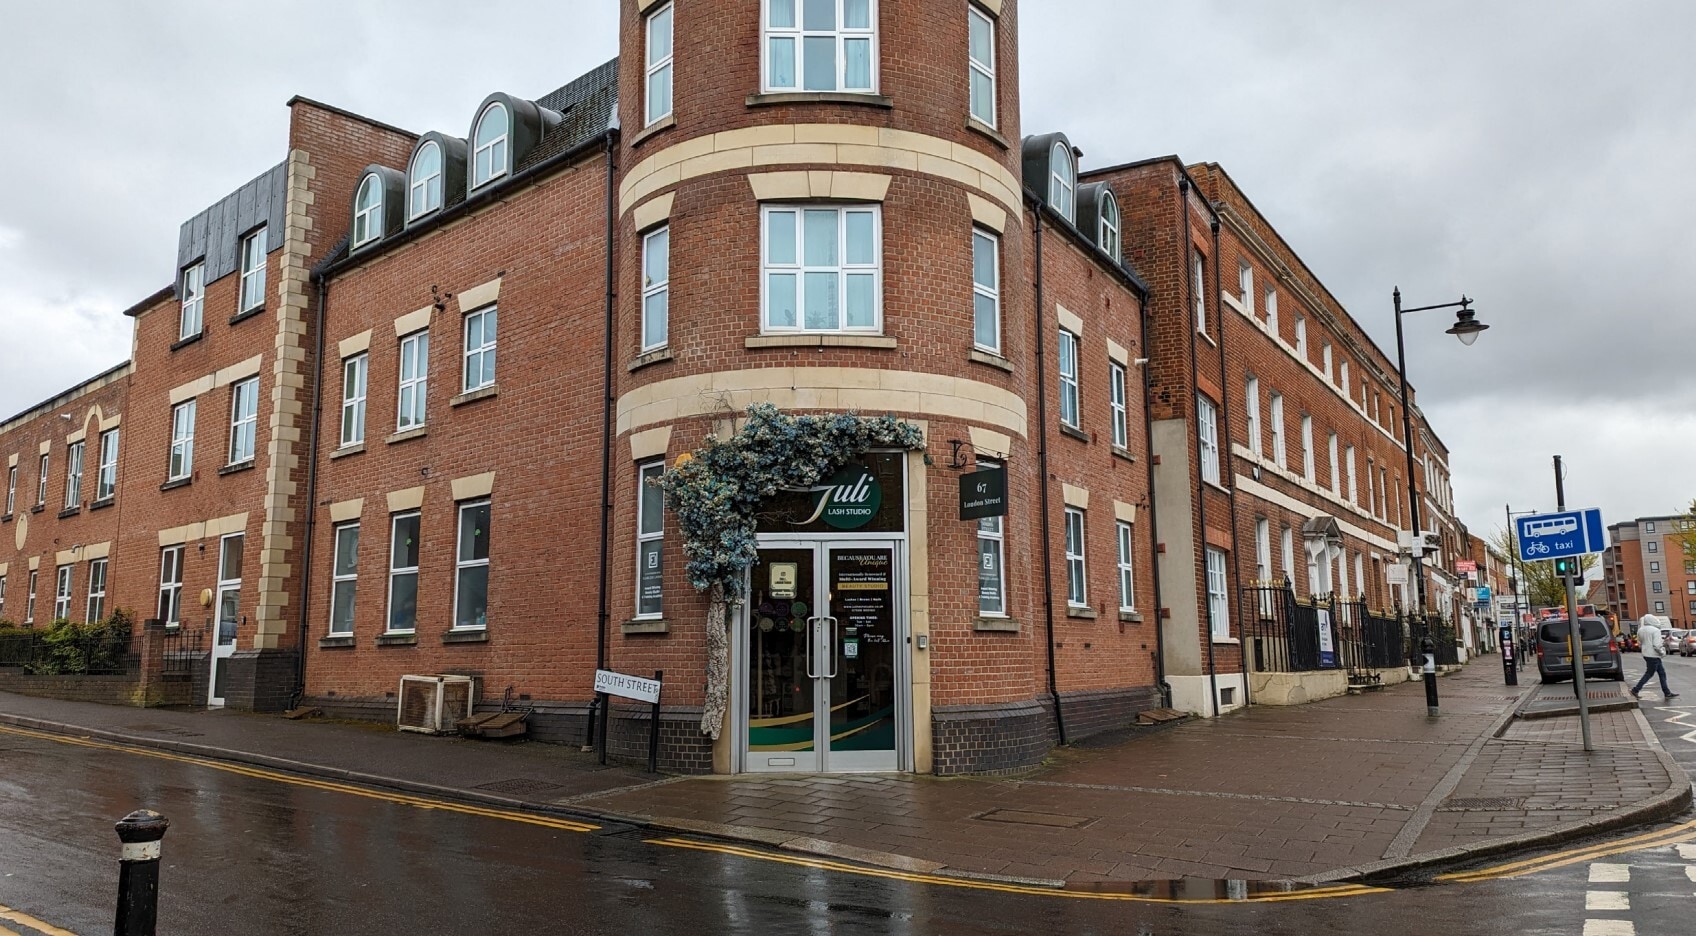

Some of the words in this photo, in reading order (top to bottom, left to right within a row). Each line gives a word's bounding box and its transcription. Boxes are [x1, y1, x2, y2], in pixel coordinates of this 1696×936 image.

[977, 482, 987, 493] 67
[964, 500, 984, 508] London
[984, 497, 1001, 505] Street
[1555, 540, 1574, 550] taxi
[859, 559, 888, 568] Unique
[597, 673, 624, 687] SOUTH
[627, 680, 658, 693] STREET
